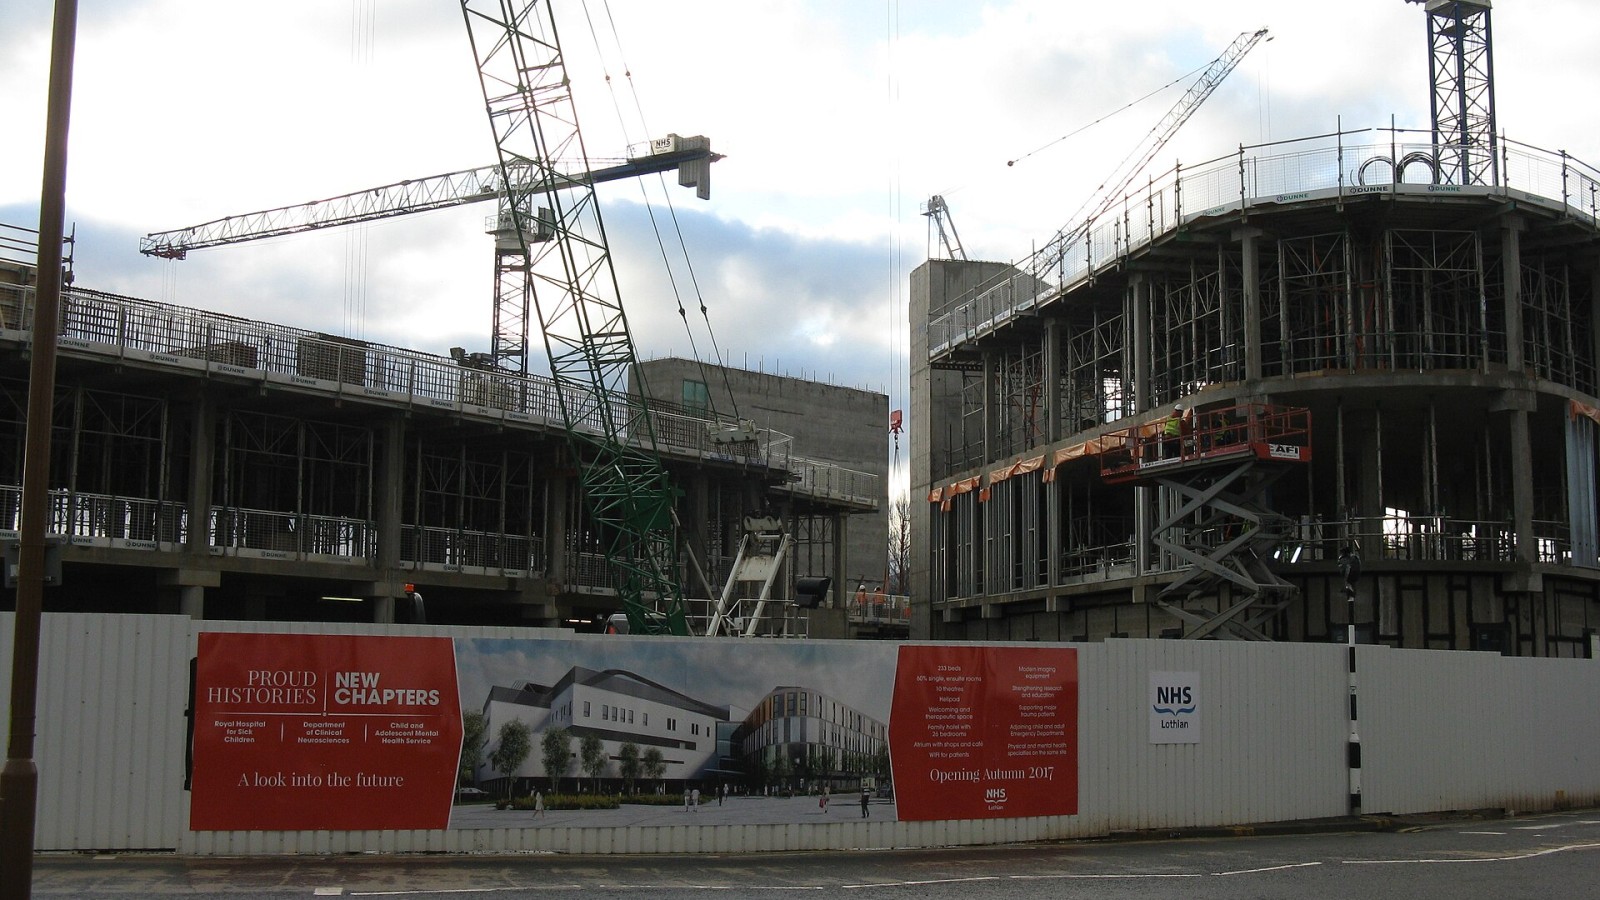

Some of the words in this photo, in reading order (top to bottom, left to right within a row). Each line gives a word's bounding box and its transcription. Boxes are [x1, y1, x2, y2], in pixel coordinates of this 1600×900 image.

[656, 138, 671, 147] NHS
[1357, 185, 1388, 193] DUNNE
[1283, 193, 1309, 201] DUNNE
[63, 339, 91, 349] DUNNE
[155, 356, 180, 364] DUNNE
[223, 365, 245, 374] DUNNE
[295, 377, 317, 386] DUNNE
[368, 389, 389, 398] DUNNE
[131, 541, 157, 550] DUNNE
[247, 669, 318, 687] PROUD
[335, 671, 380, 688] NEW
[207, 687, 317, 705] HISTORIES
[334, 688, 440, 706] CHAPTERS
[1157, 686, 1192, 704] NHS
[214, 720, 235, 729] Royal
[236, 720, 266, 729] Hospital
[303, 721, 345, 729] Department
[1161, 720, 1189, 729] Lothian
[405, 737, 432, 745] Service
[929, 767, 980, 783] Opening
[983, 767, 1025, 781] Autumn
[1028, 766, 1054, 781] 2017
[237, 773, 251, 787] A
[254, 771, 287, 787] look
[292, 772, 322, 788] into
[327, 772, 351, 787] the
[356, 772, 404, 788] future
[986, 788, 1006, 798] NHS
